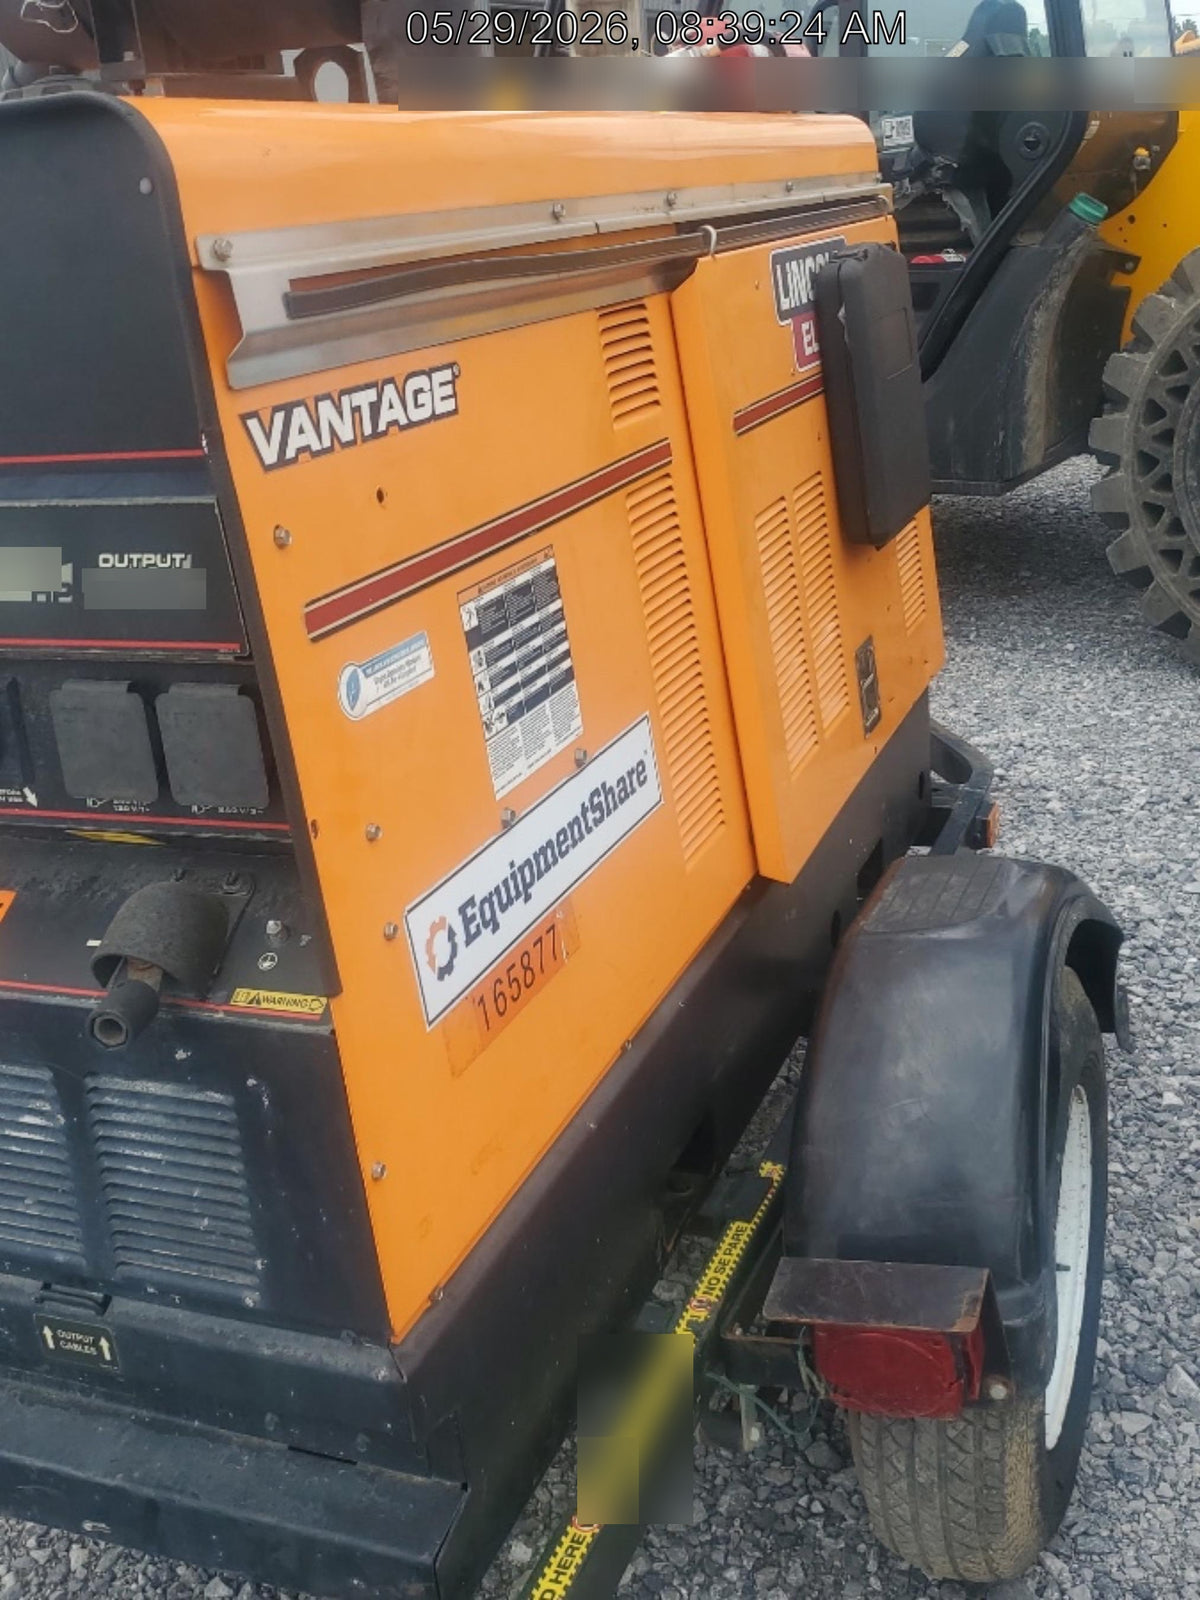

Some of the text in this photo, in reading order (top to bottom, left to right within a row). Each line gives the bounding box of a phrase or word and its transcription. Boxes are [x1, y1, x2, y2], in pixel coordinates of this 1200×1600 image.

[776, 250, 834, 310] LINC
[801, 320, 820, 356] EL
[242, 364, 459, 469] VANTAGE
[98, 553, 185, 569] OUTPUT
[458, 757, 648, 948] EquipmentShare
[262, 994, 309, 1010] WARNING
[476, 924, 557, 1031] 165877
[702, 1277, 721, 1296] NO
[725, 1224, 748, 1258] PARE
[56, 1329, 95, 1344] OUTPUT
[60, 1339, 98, 1356] CABLES
[548, 1532, 587, 1585] HERE
